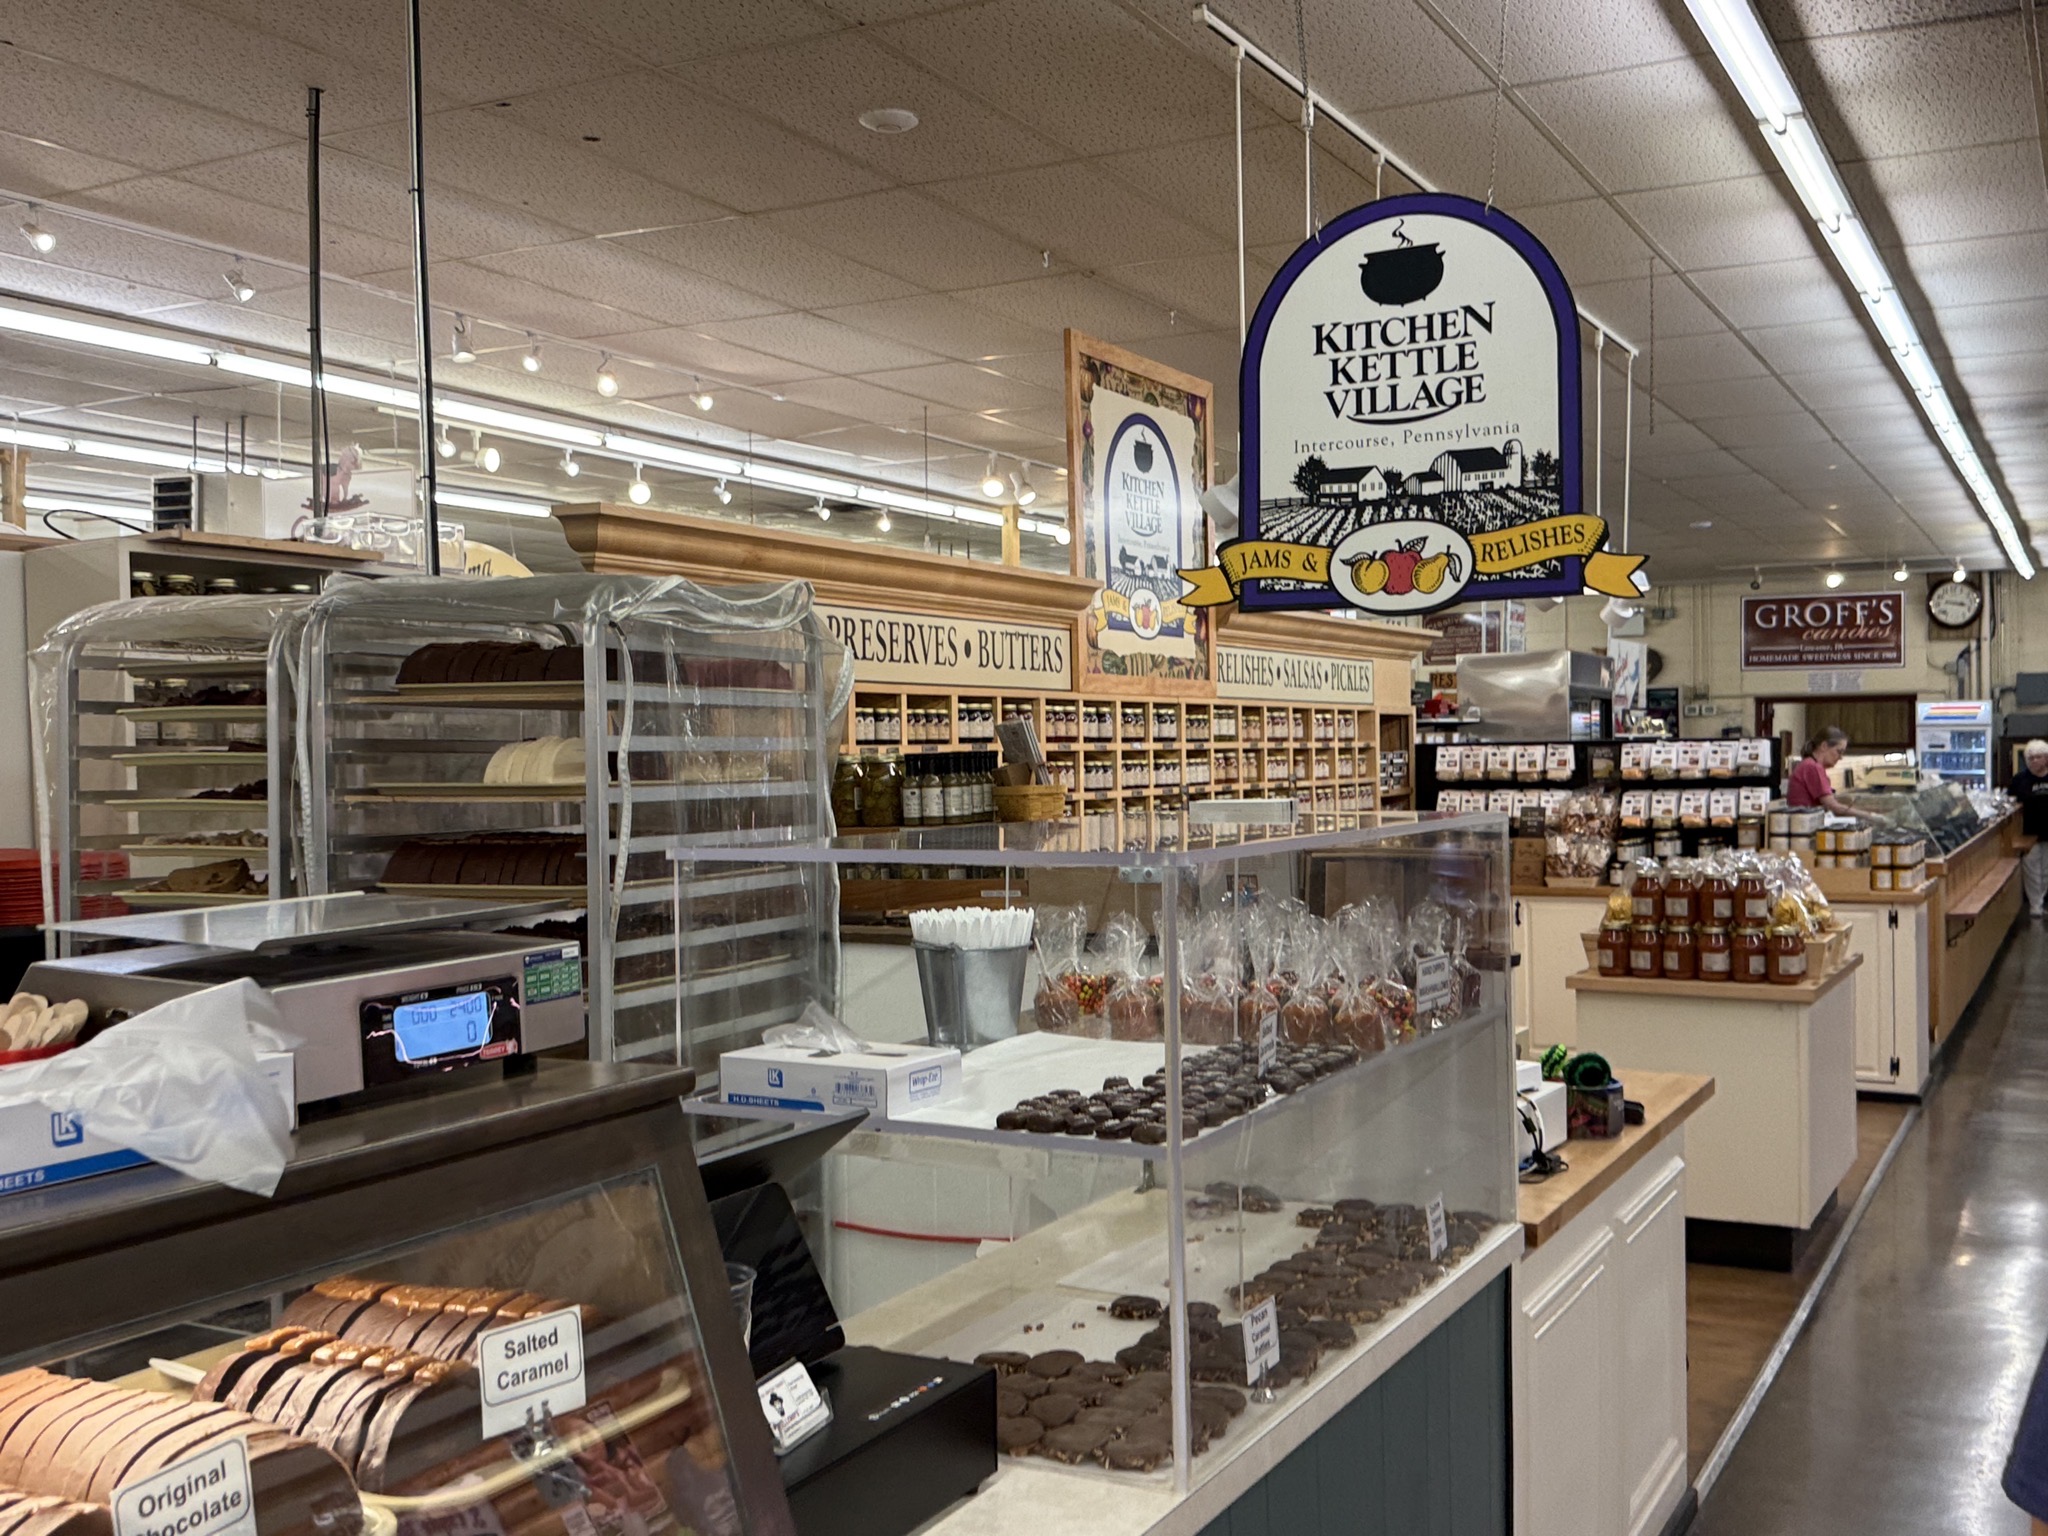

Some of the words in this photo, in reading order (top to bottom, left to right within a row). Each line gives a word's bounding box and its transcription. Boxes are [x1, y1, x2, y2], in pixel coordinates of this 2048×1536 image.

[1312, 301, 1496, 356] KITCHEN
[1329, 340, 1479, 387] KETTLE
[1323, 373, 1487, 419] VILLAGE
[1293, 433, 1396, 455] Intercourse,
[1403, 420, 1521, 446] Pennsylvania
[1122, 471, 1164, 498] KITCHEN
[1125, 510, 1163, 534] VILLAGE
[1126, 492, 1161, 517] KETTLE
[1240, 551, 1292, 575] JAMS
[1302, 552, 1319, 573] &
[1480, 523, 1586, 563] RELISHES
[1755, 599, 1893, 629] GROFF'S
[1802, 616, 1893, 641] candies
[826, 615, 957, 667] PRESERVES
[977, 629, 1063, 673] BUTTERS
[1749, 653, 1799, 663] HOMEMADE
[1802, 652, 1852, 662] SWEETNESS
[1854, 651, 1879, 661] SINCE
[1217, 652, 1274, 687] RELISHES
[1284, 658, 1323, 690] SALSAS
[1331, 663, 1370, 692] PICKLES
[504, 1327, 558, 1359] Salted
[497, 1352, 569, 1390] Caramel
[138, 1459, 226, 1518] Original
[136, 1491, 242, 1536] ocolate
